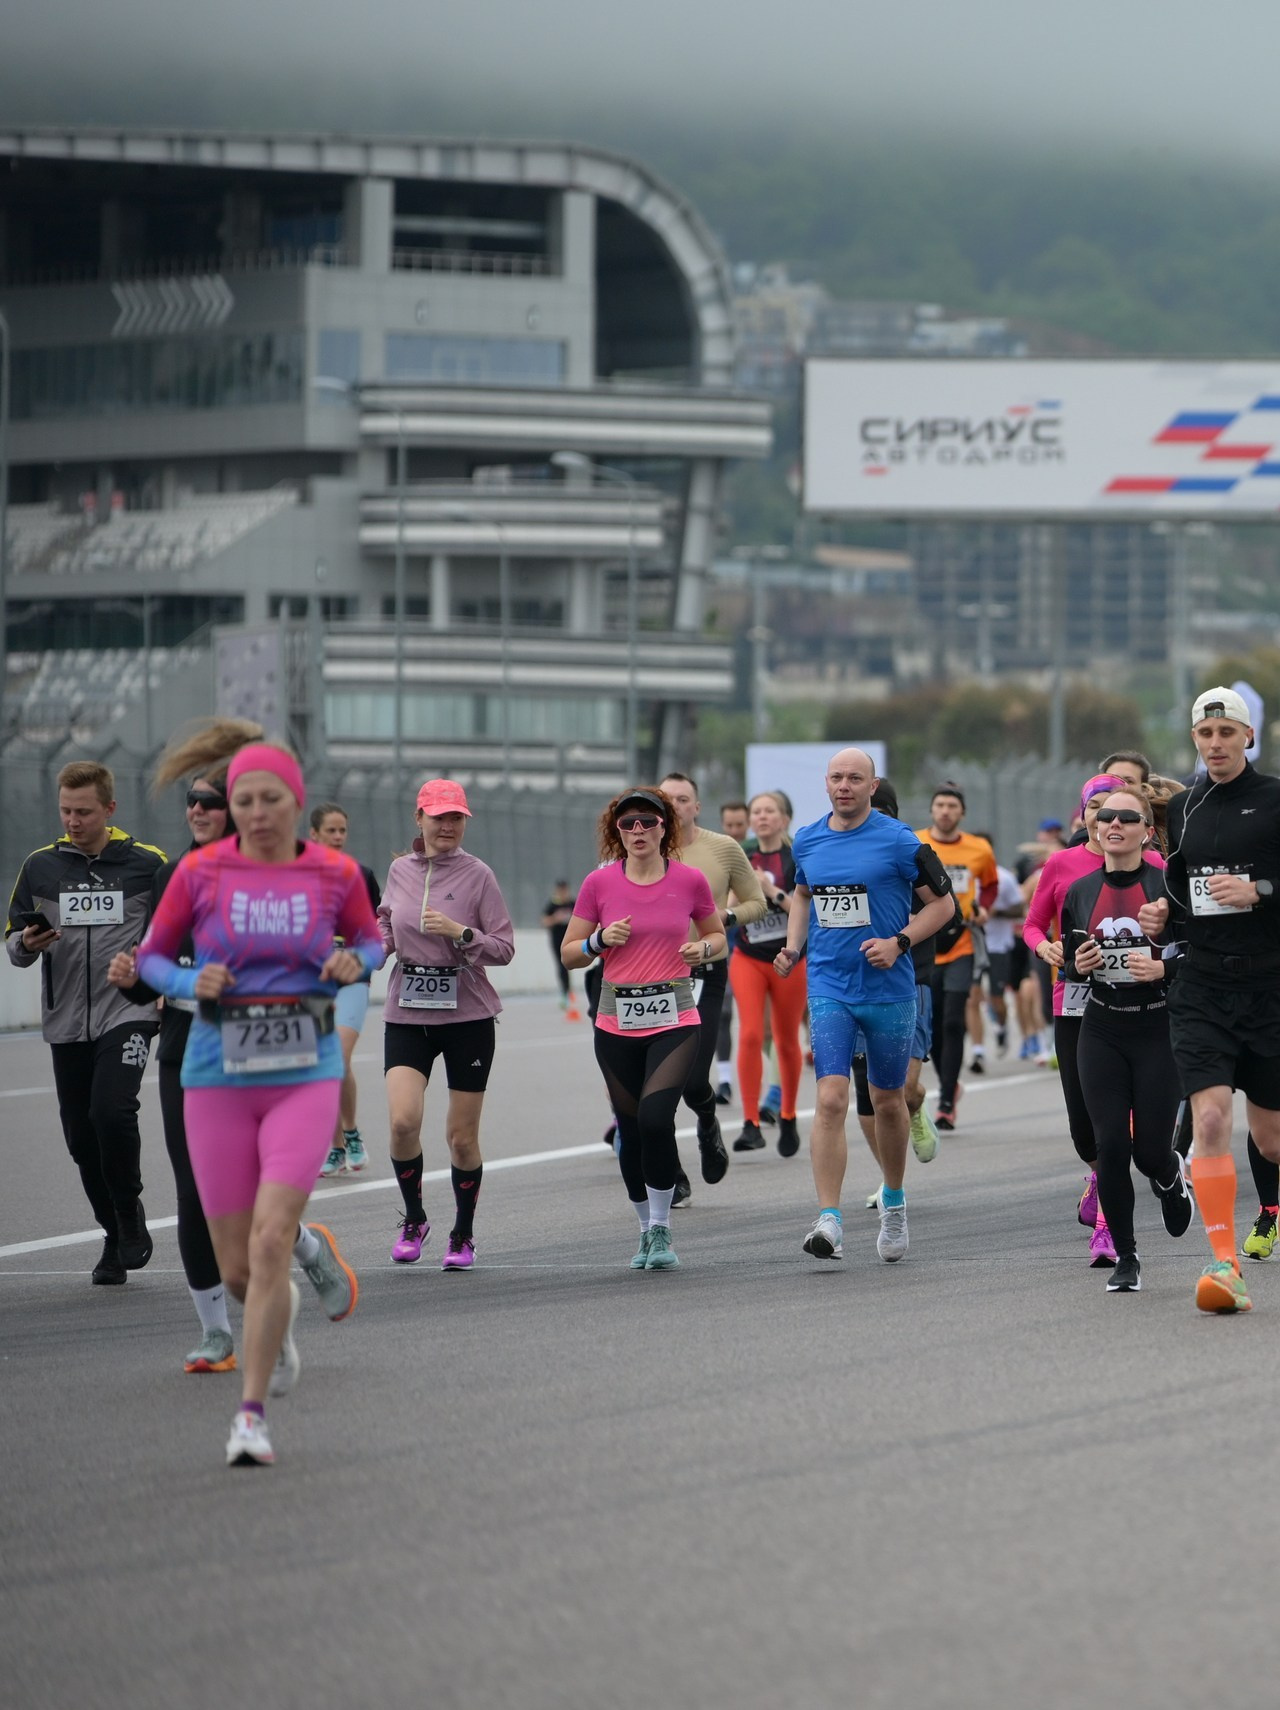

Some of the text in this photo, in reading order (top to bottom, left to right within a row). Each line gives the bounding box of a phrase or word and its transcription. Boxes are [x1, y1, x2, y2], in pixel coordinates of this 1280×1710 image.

[860, 417, 1059, 444] СИРИУС
[861, 447, 1065, 465] АВТОДРОМ
[68, 896, 114, 912] 2019
[819, 896, 860, 911] 7731
[405, 976, 451, 993] 7205
[622, 999, 671, 1018] 7942
[236, 1019, 303, 1047] 7231
